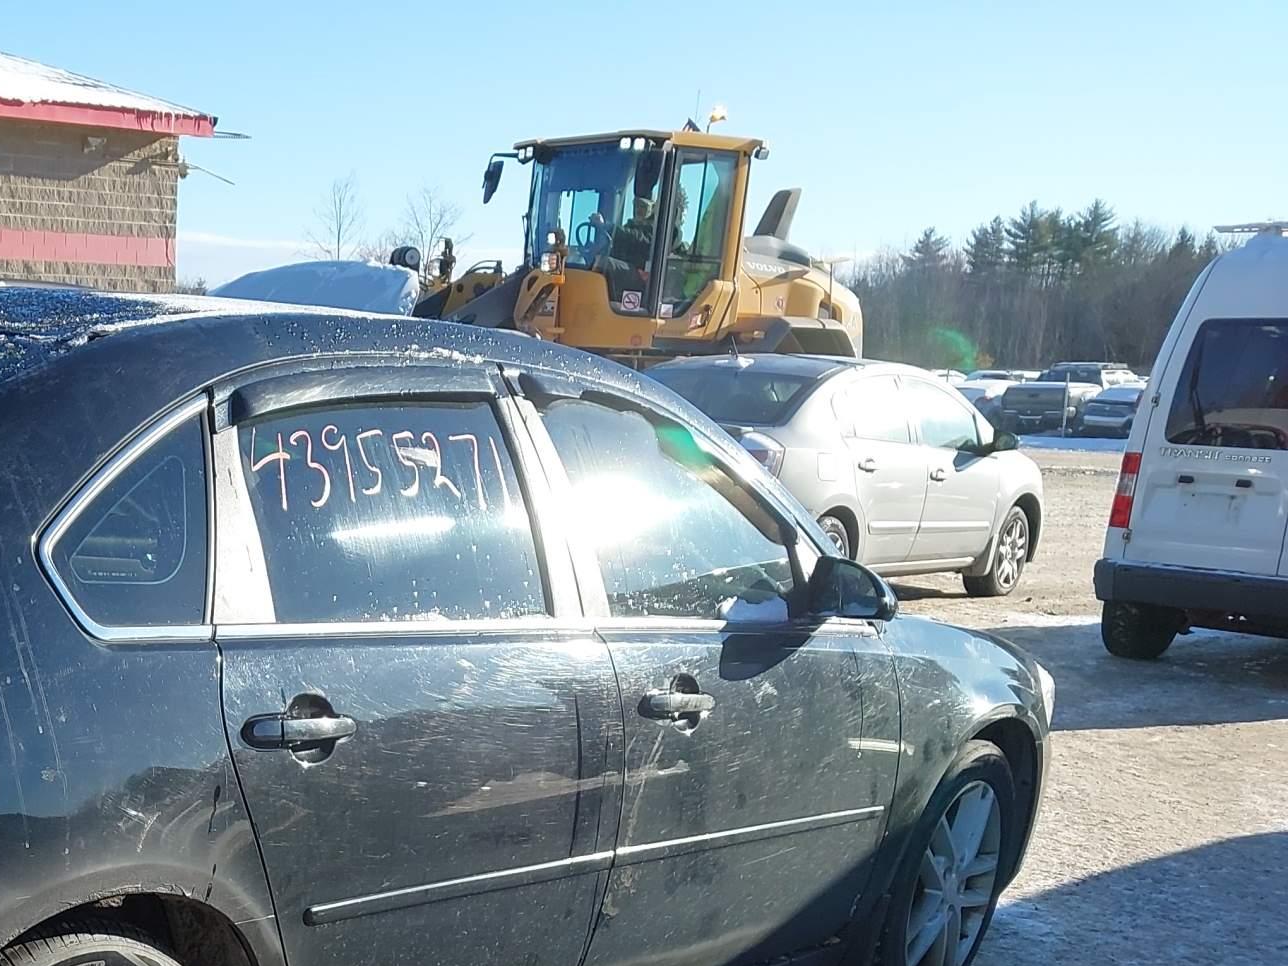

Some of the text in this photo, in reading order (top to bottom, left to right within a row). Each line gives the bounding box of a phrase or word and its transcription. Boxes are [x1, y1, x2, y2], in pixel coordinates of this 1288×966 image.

[747, 261, 786, 273] VOLVO
[1160, 446, 1223, 460] TRANSIT
[251, 424, 509, 511] 43955271
